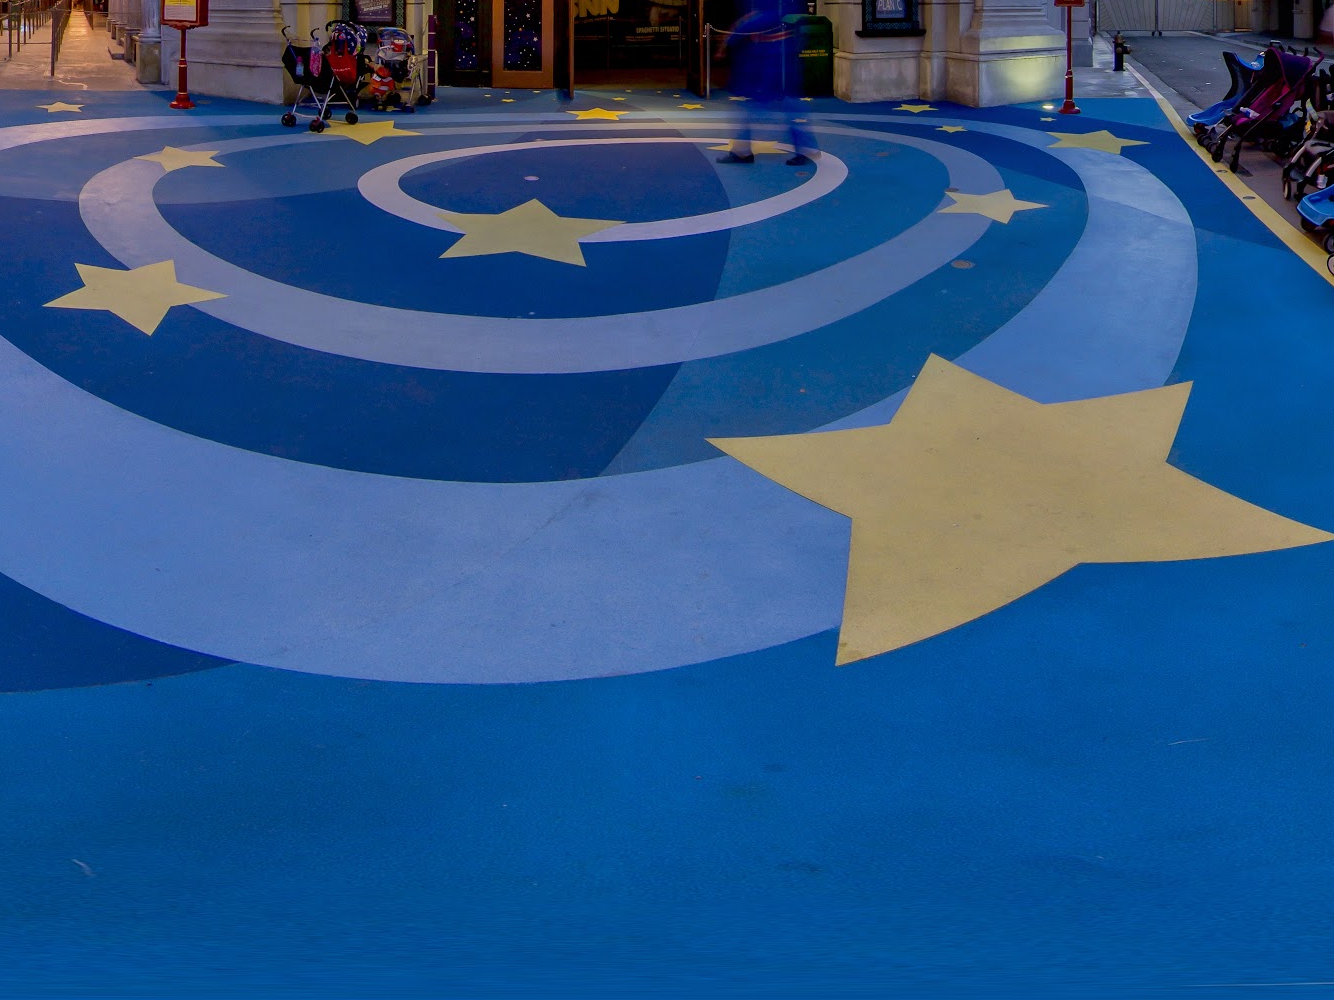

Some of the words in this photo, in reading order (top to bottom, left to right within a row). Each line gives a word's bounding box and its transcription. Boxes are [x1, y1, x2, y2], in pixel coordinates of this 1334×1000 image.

[877, 0, 895, 11] PLAN
[896, 0, 903, 11] C
[635, 26, 659, 34] SPAGHETTI
